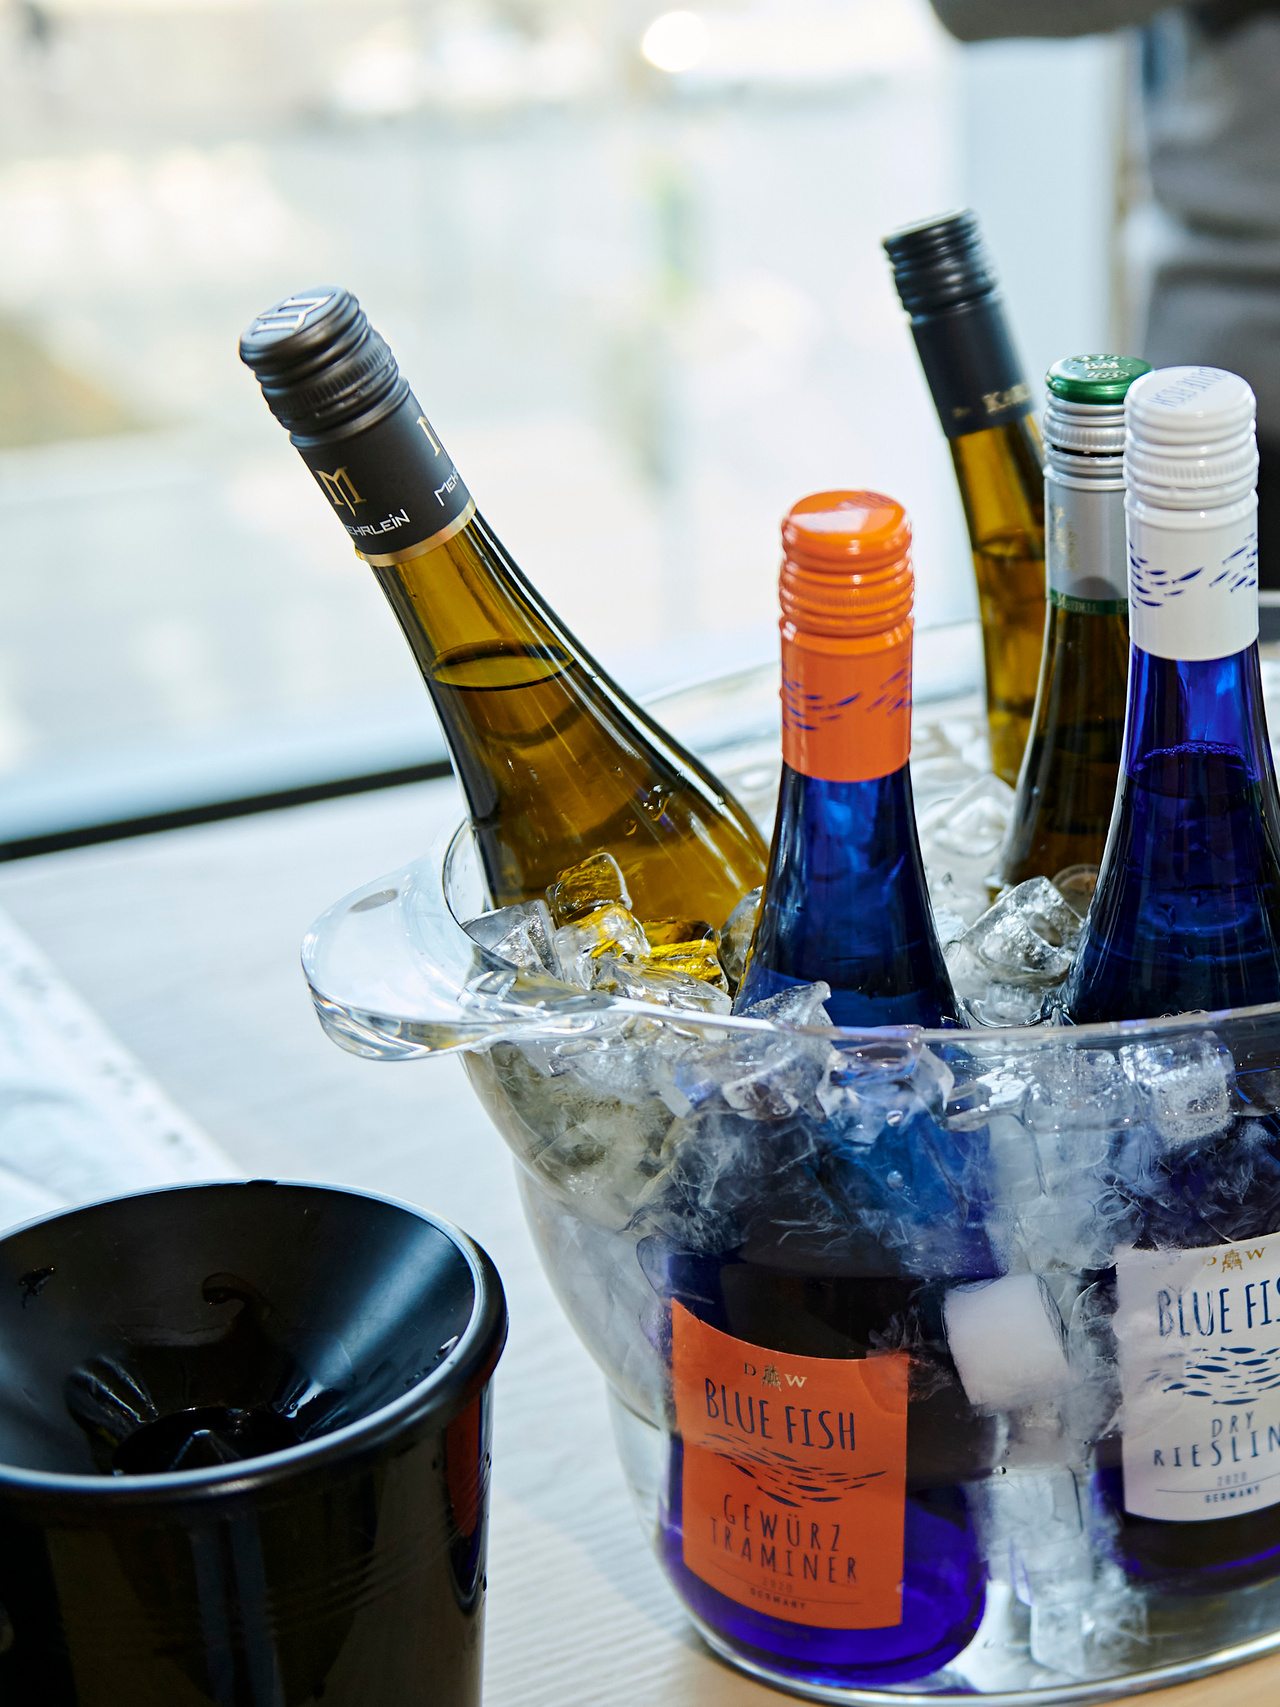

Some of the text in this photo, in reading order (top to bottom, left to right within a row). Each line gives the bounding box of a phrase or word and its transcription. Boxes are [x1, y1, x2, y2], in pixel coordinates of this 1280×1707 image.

[1157, 1288, 1232, 1337] BLUE
[705, 1377, 856, 1451] BLUE FISH
[1211, 1411, 1254, 1438] DRY
[1204, 1484, 1261, 1504] GERMANY
[723, 1494, 841, 1552] GEWÜRZ
[710, 1516, 857, 1584] TRAMINER
[750, 1587, 807, 1610] GERMANY
